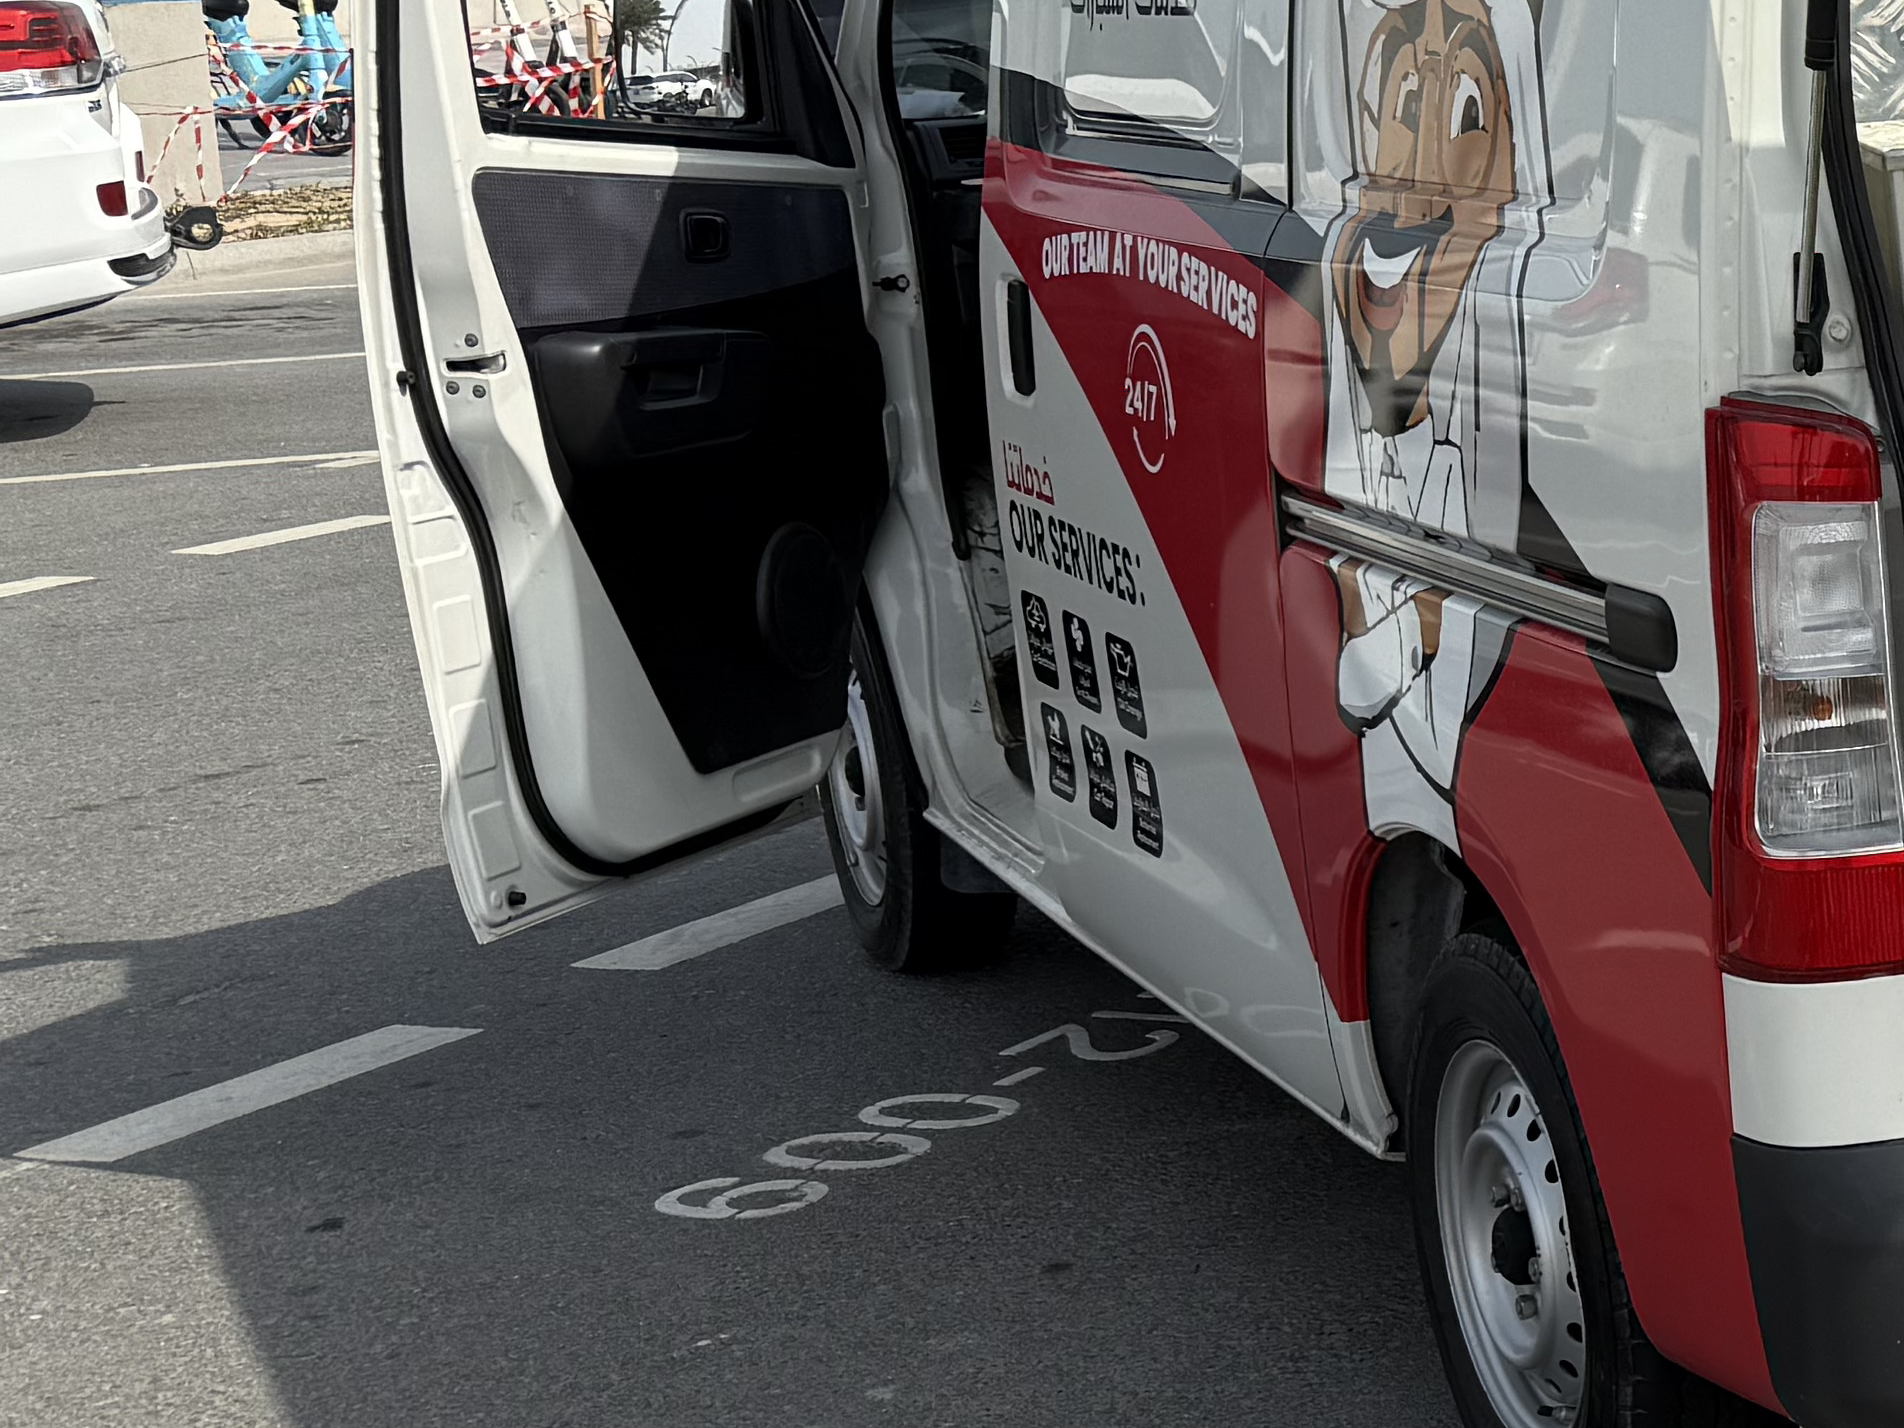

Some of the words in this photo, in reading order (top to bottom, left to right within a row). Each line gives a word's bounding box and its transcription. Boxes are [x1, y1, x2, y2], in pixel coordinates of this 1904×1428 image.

[1042, 236, 1070, 279] OUR
[1070, 231, 1109, 274] TEAM
[1112, 232, 1134, 277] AT
[1136, 236, 1179, 294] YOUR
[1180, 252, 1258, 340] SERVICES
[1124, 377, 1158, 422] 24/7
[1002, 440, 1056, 506] خدماتنا
[1009, 499, 1049, 565] OUR
[1048, 515, 1146, 607] SERVICES:
